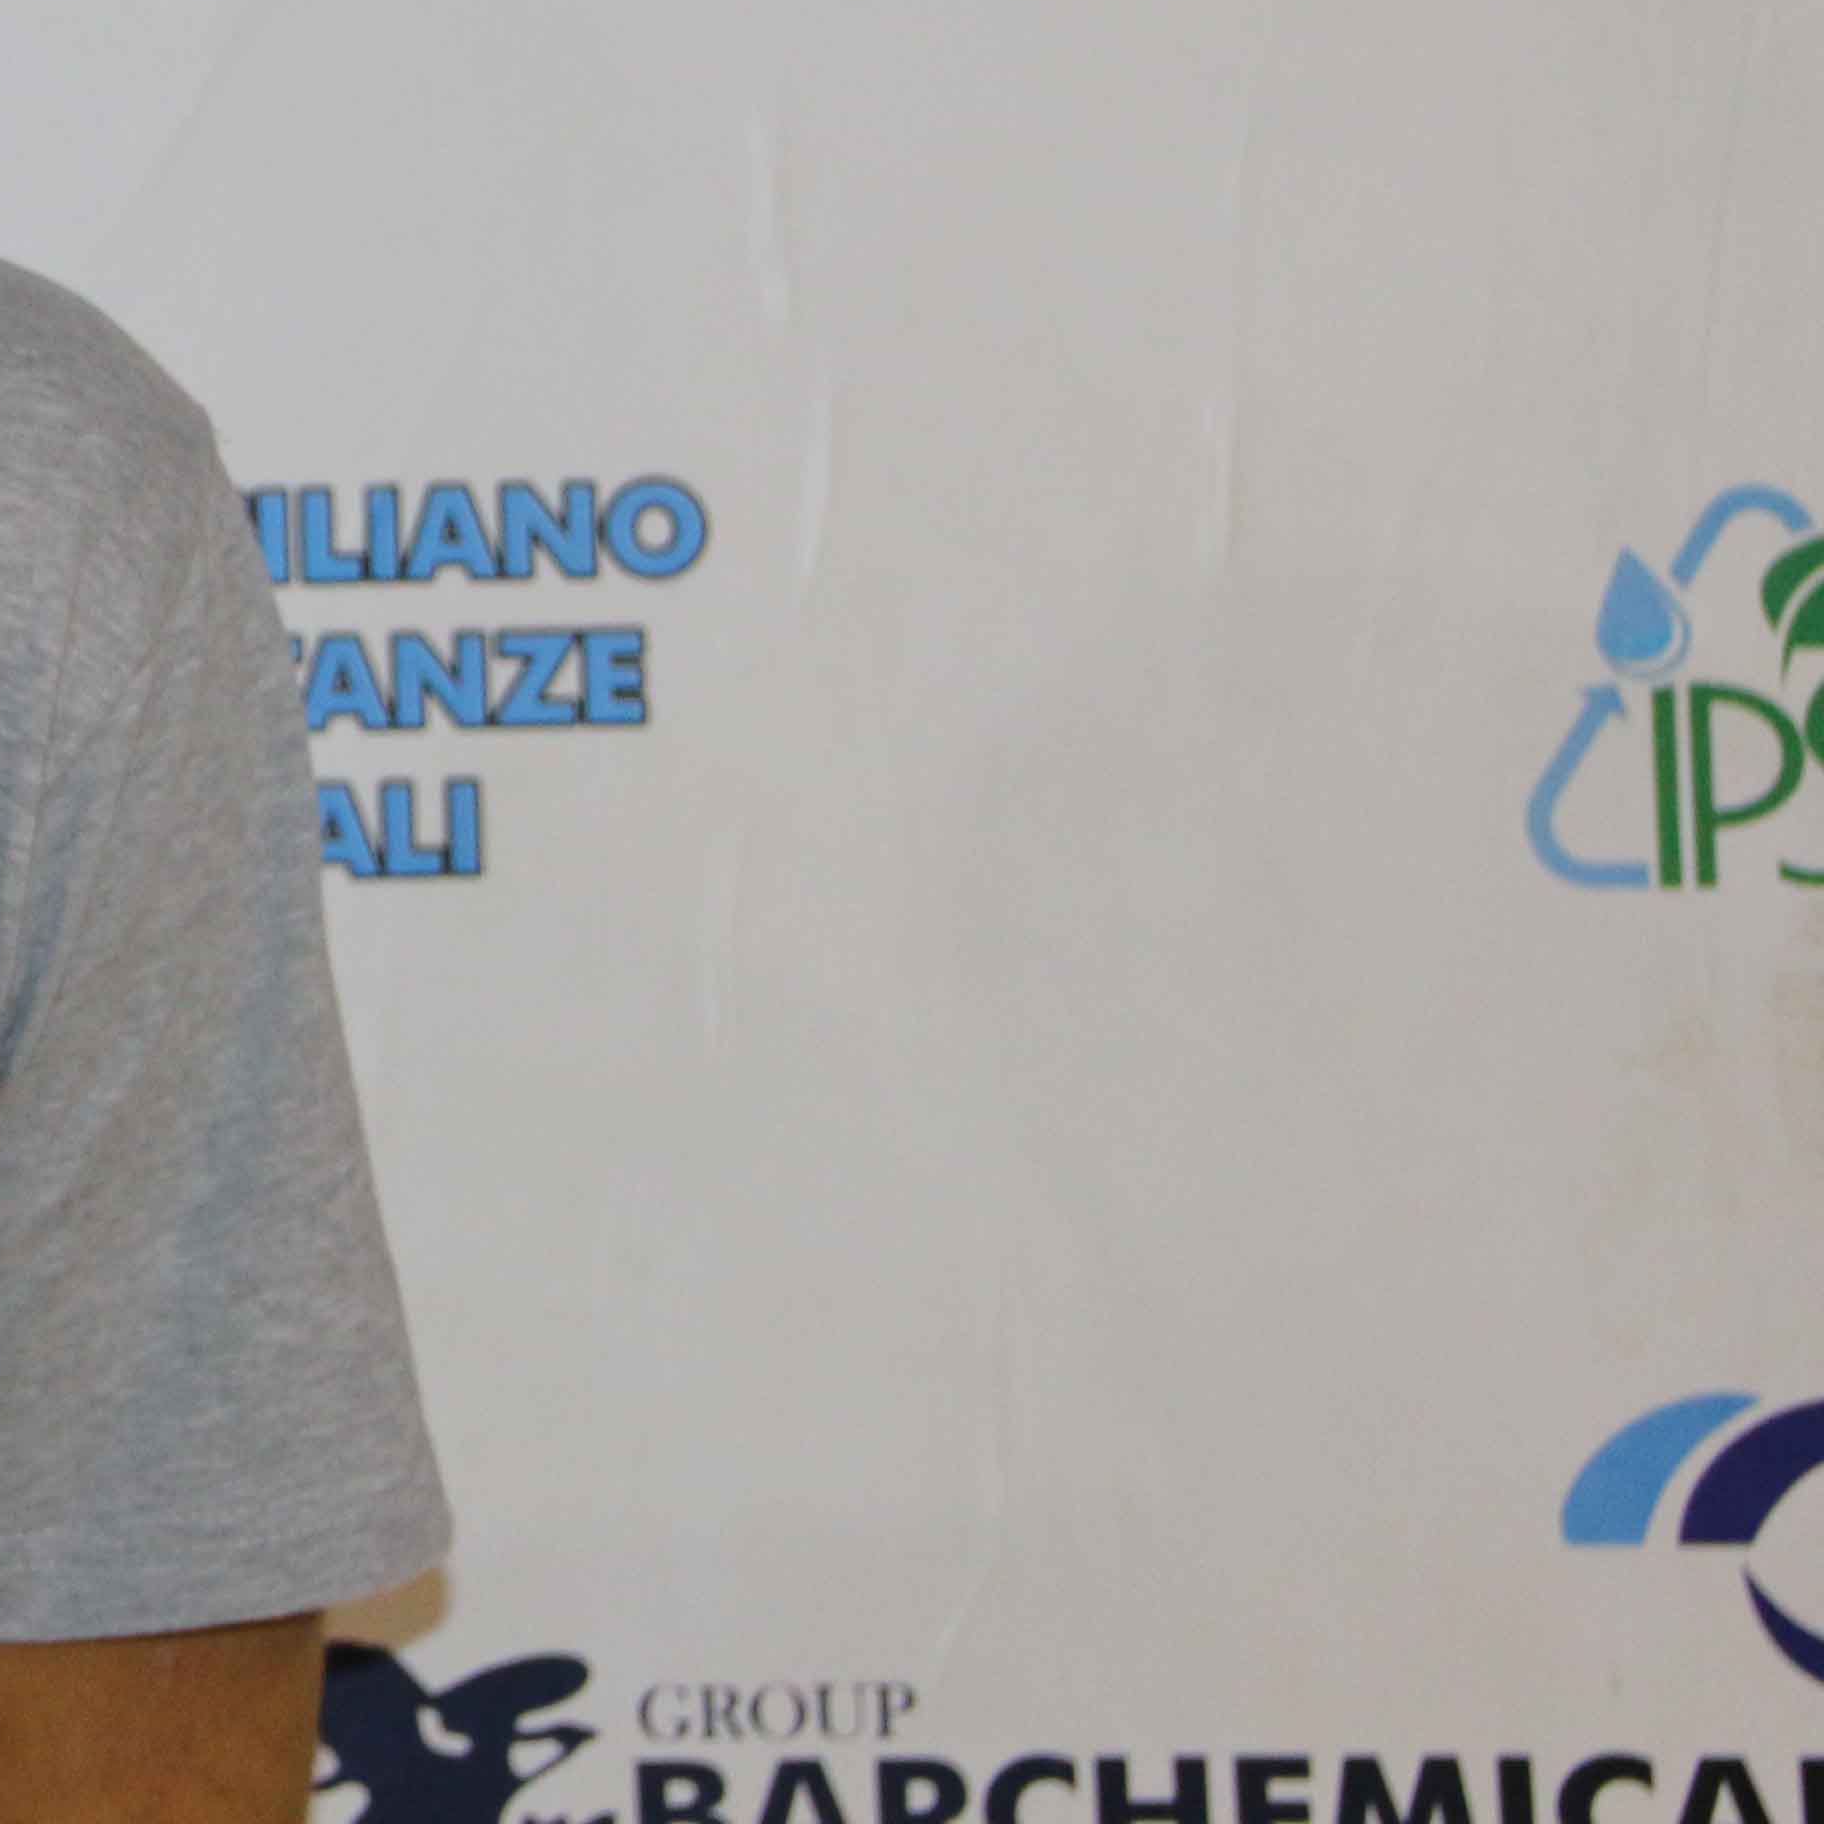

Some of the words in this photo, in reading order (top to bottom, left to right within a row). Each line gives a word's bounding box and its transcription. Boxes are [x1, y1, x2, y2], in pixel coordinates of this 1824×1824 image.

[245, 477, 707, 584] ILIANO
[292, 626, 648, 731] ANZE
[316, 777, 482, 877] ALI
[636, 1680, 916, 1741] GROUP
